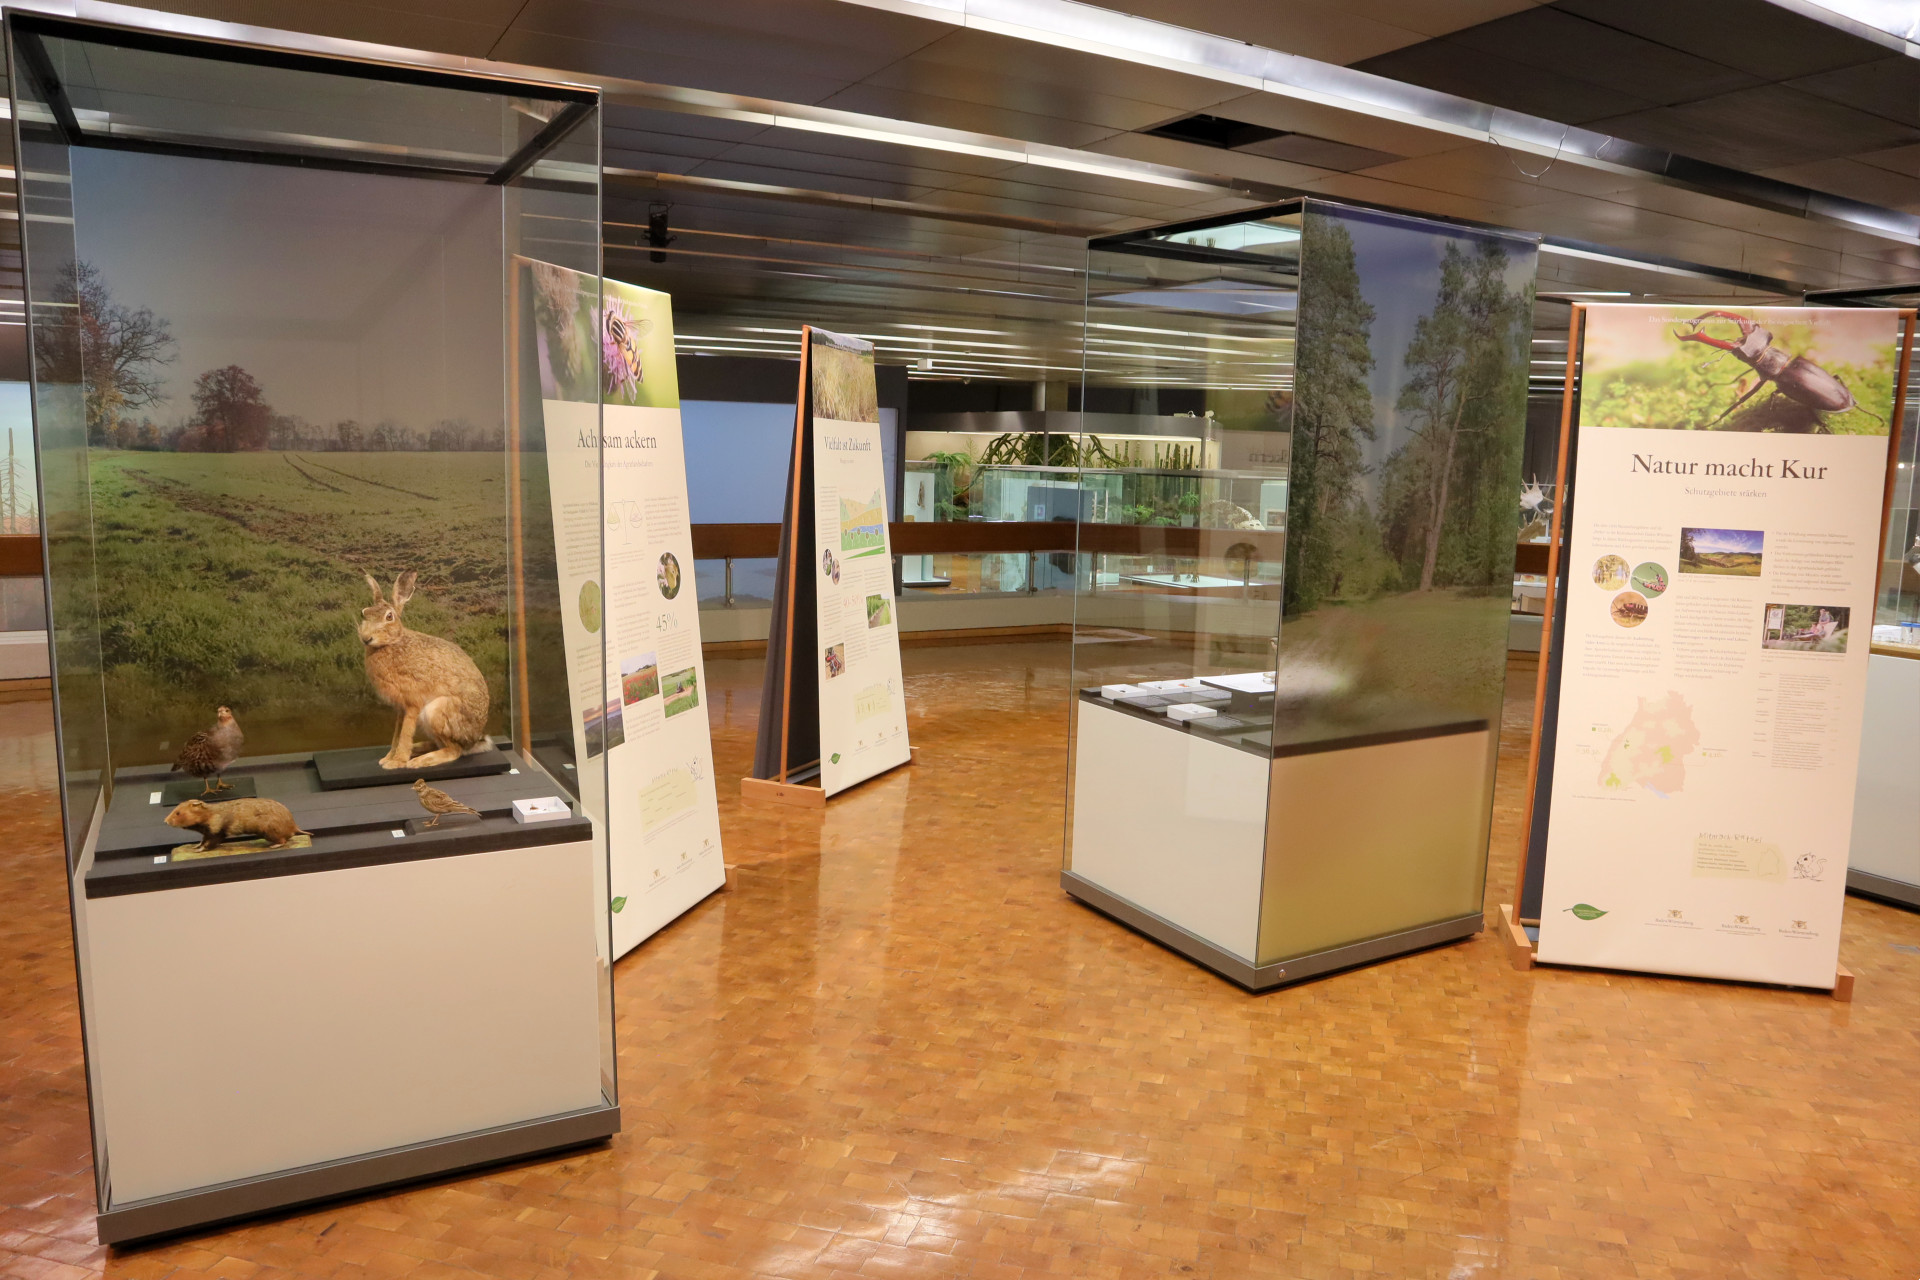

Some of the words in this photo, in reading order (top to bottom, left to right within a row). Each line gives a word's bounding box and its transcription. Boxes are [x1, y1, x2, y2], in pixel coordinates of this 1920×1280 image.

[577, 428, 622, 449] Achsam
[625, 429, 657, 449] ackern
[1631, 453, 1698, 476] Natur
[1704, 457, 1774, 479] macht
[1780, 459, 1828, 480] Kur
[1684, 487, 1737, 499] Schutzgebiete
[1739, 489, 1767, 498] stärken
[656, 612, 678, 633] 45%
